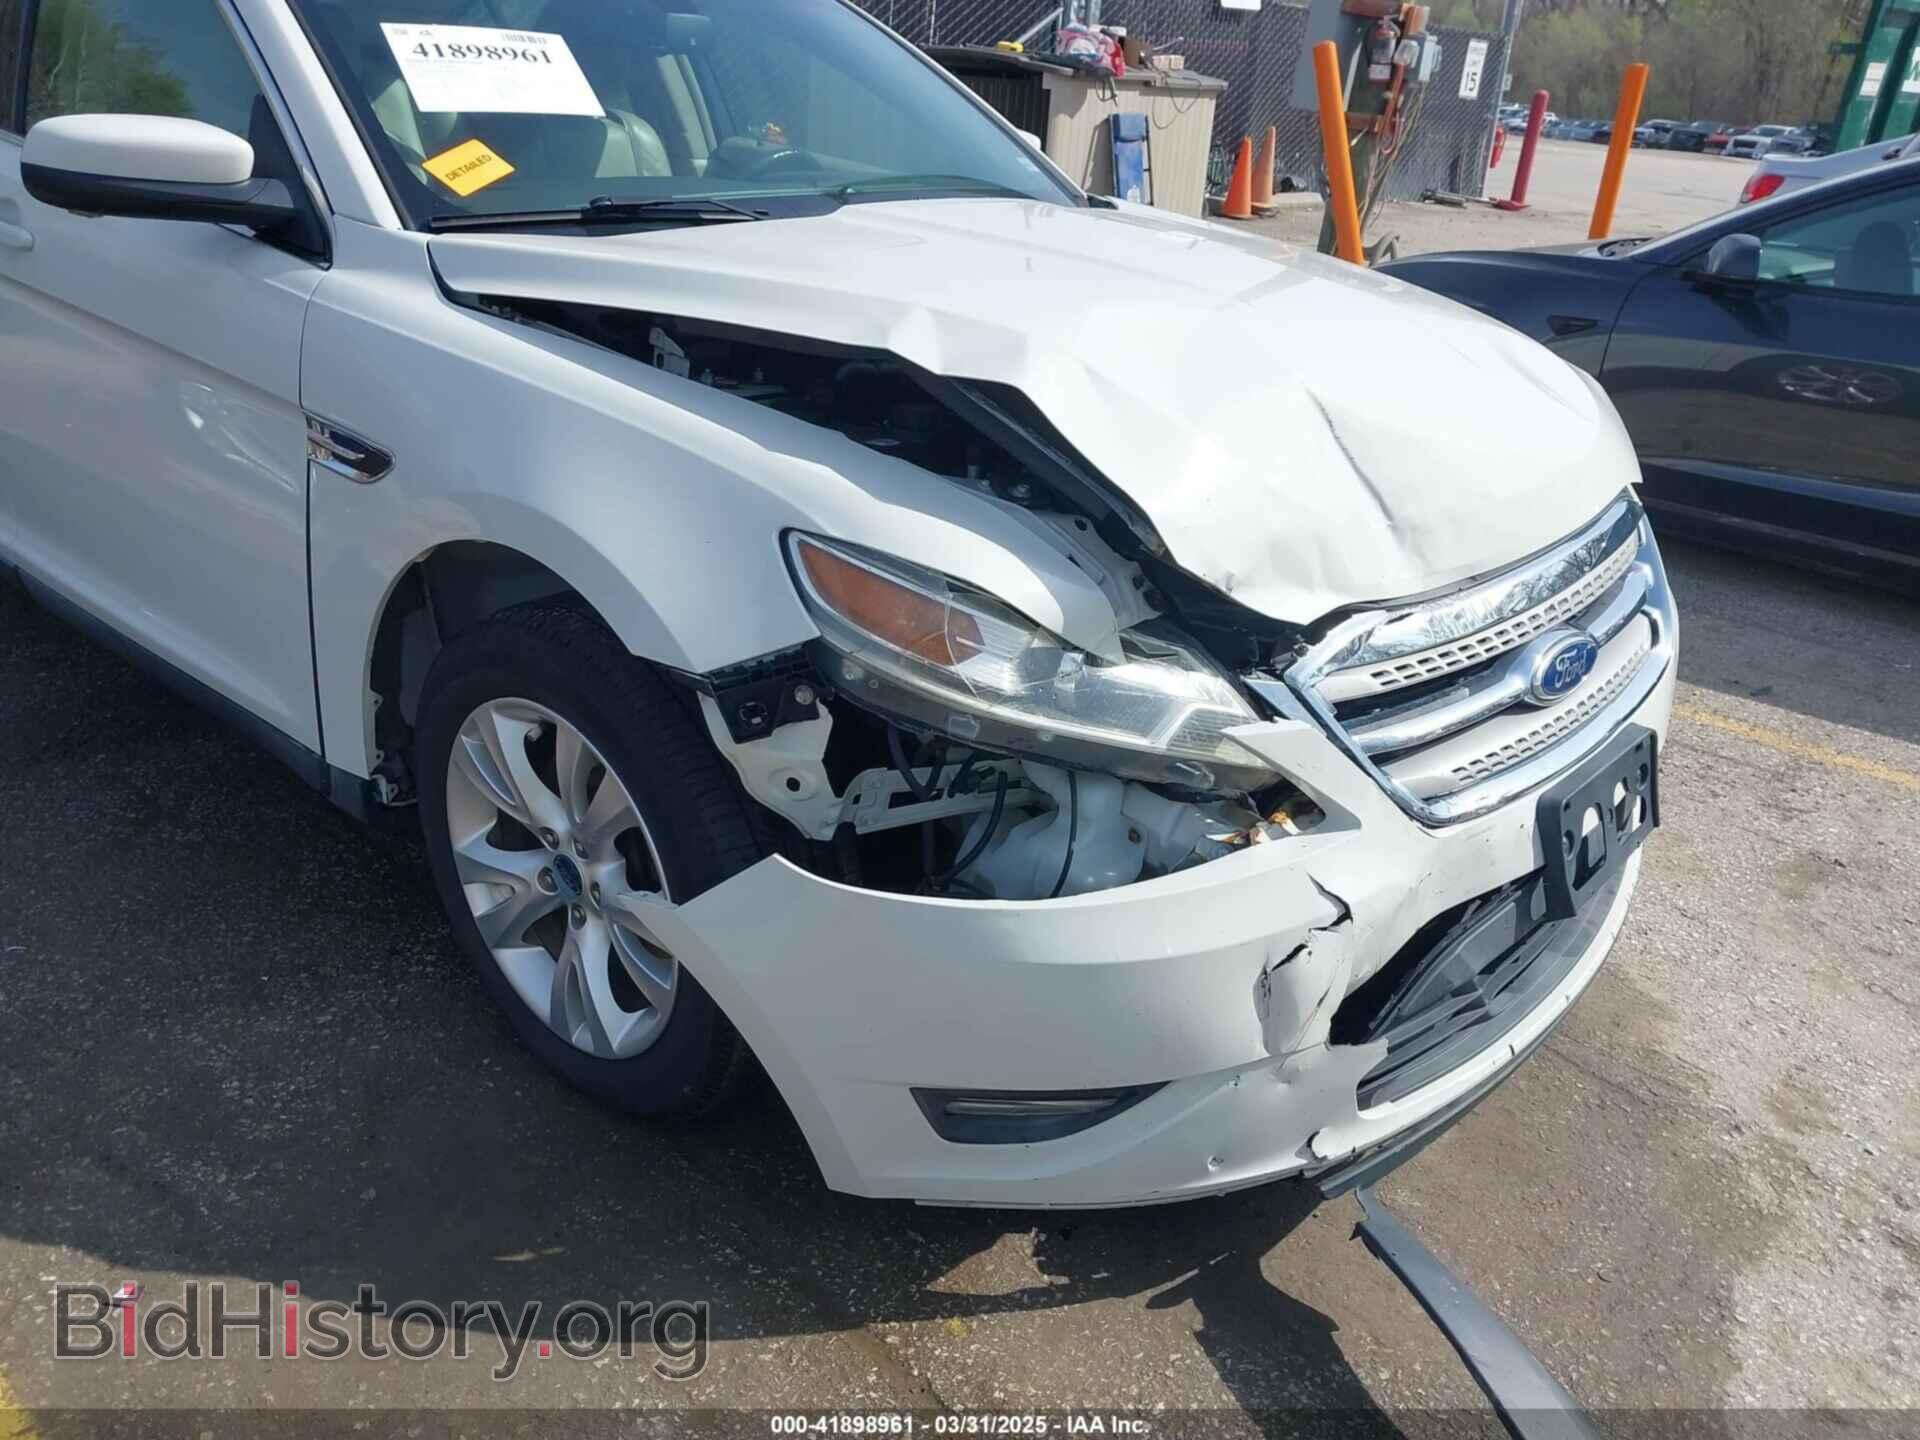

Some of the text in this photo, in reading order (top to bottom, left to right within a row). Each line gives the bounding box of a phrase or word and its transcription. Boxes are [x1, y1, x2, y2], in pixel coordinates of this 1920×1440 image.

[412, 42, 552, 64] 41898961
[1464, 71, 1478, 92] 15
[445, 154, 492, 181] DETAILED
[1554, 647, 1588, 689] Ford
